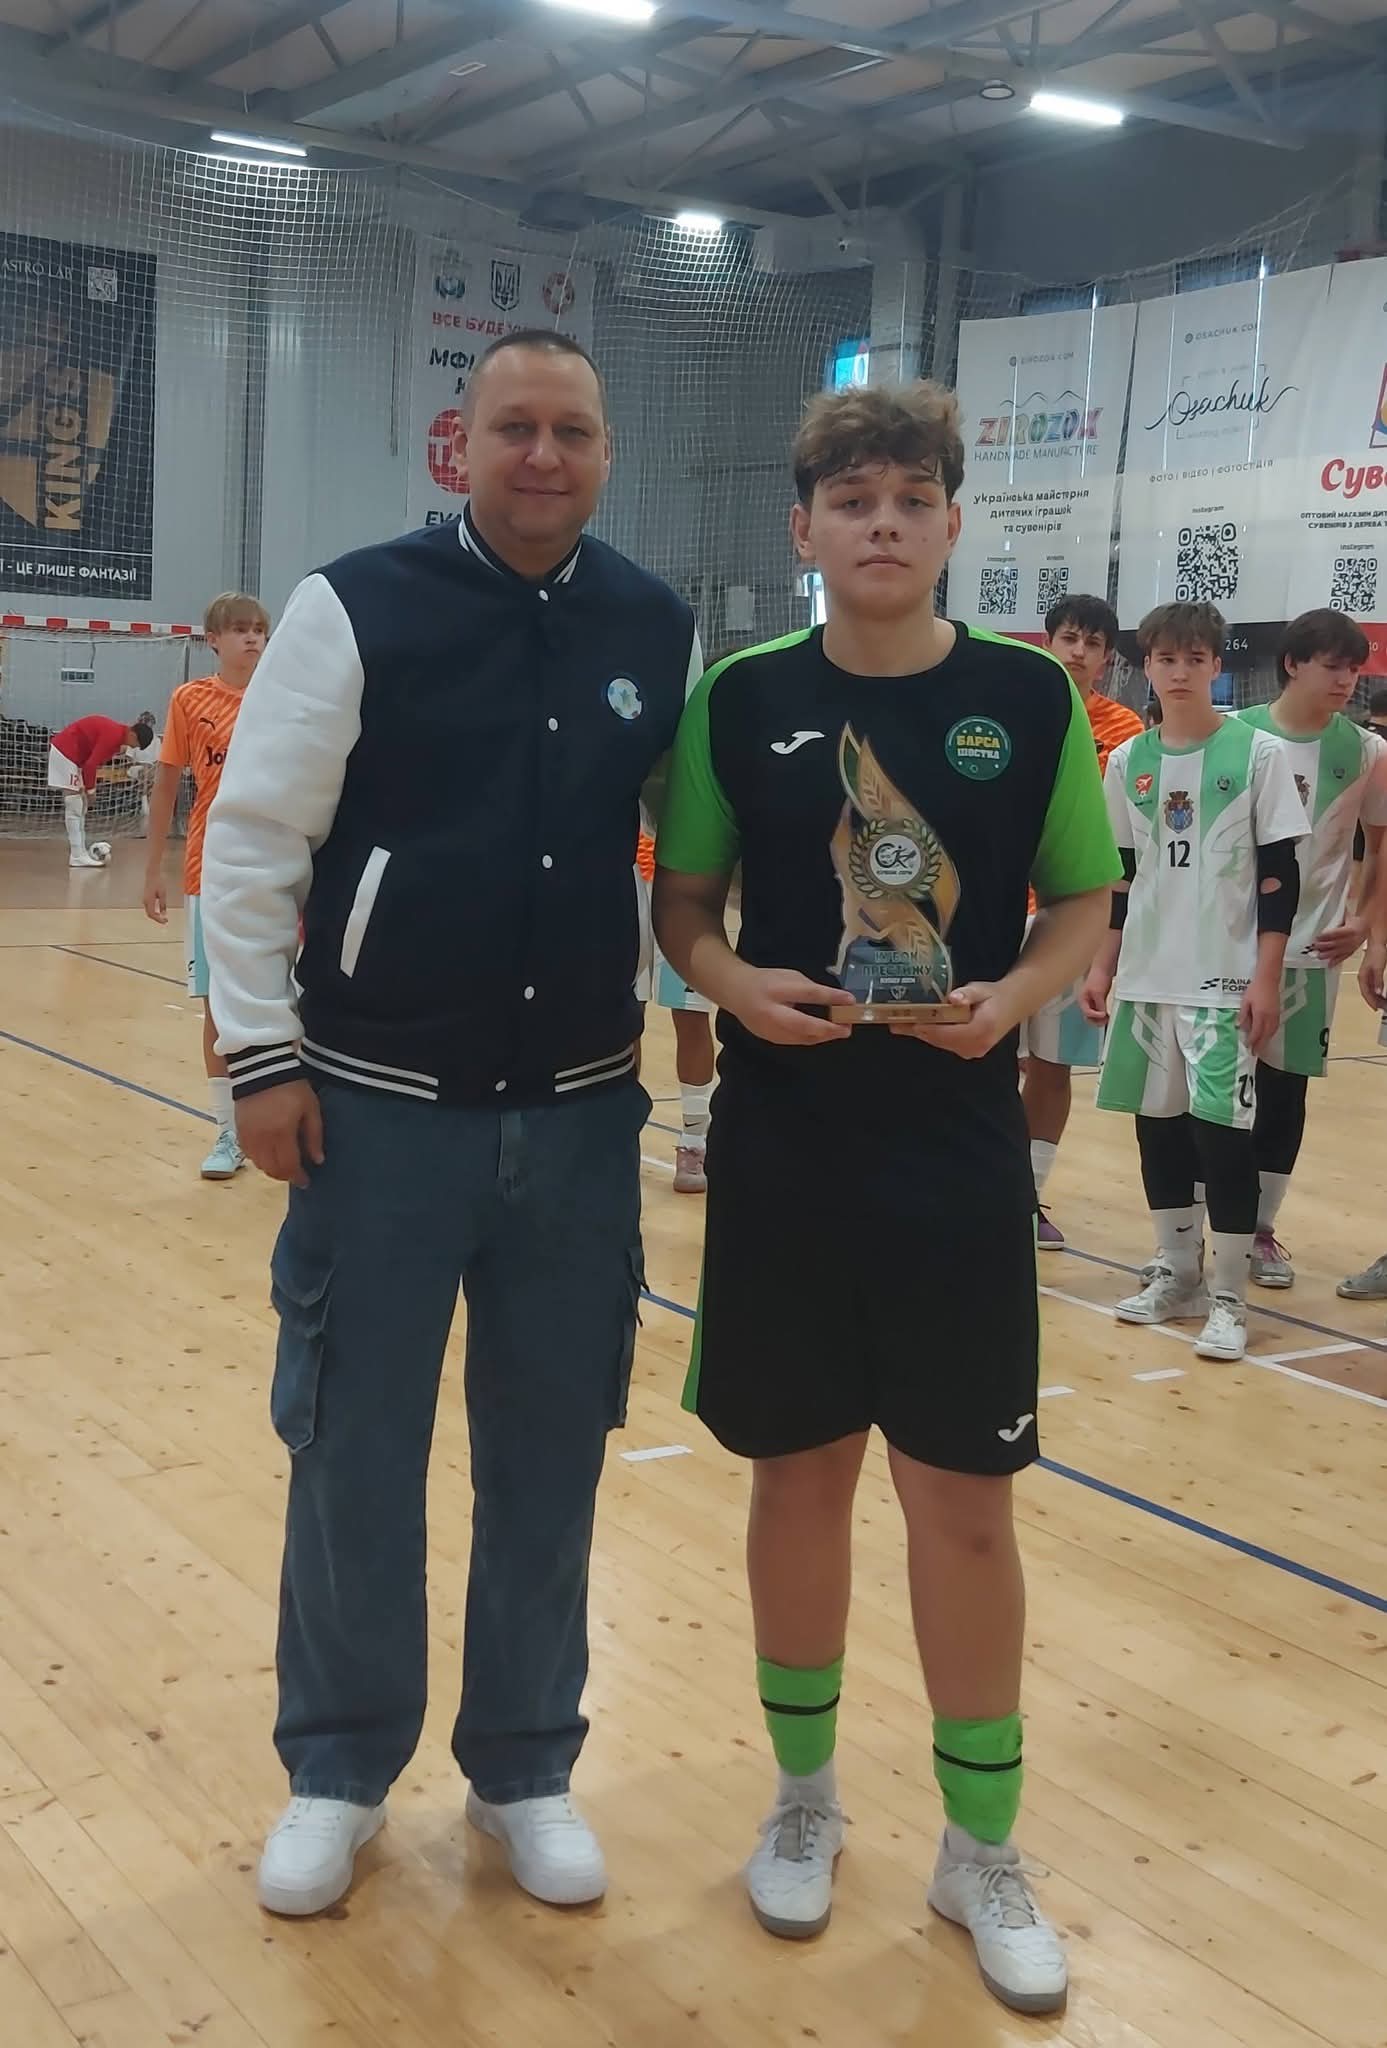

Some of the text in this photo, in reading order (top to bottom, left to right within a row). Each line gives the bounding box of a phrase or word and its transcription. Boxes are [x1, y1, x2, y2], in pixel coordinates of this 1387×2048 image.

[432, 311, 461, 328] ВСЕ
[466, 318, 504, 337] БУДЕ
[1182, 469, 1208, 479] ВІДЕО
[1321, 459, 1387, 498] Сув
[990, 504, 1072, 519] дитячих іграшок
[1300, 511, 1336, 519] ОПТОВИЙ
[1004, 524, 1013, 533] та
[1354, 520, 1382, 529] ДЕРЕВА
[16, 561, 33, 576] ЦЕ
[36, 563, 75, 577] ЛИШЕ
[78, 565, 137, 581] ФАНТАЗІЇ
[1225, 638, 1248, 650] 264
[956, 735, 1001, 748] БАРСА
[957, 748, 1000, 760] ШОСТКА
[1167, 840, 1191, 868] 12
[863, 965, 932, 977] ПРЕСТИЖУ
